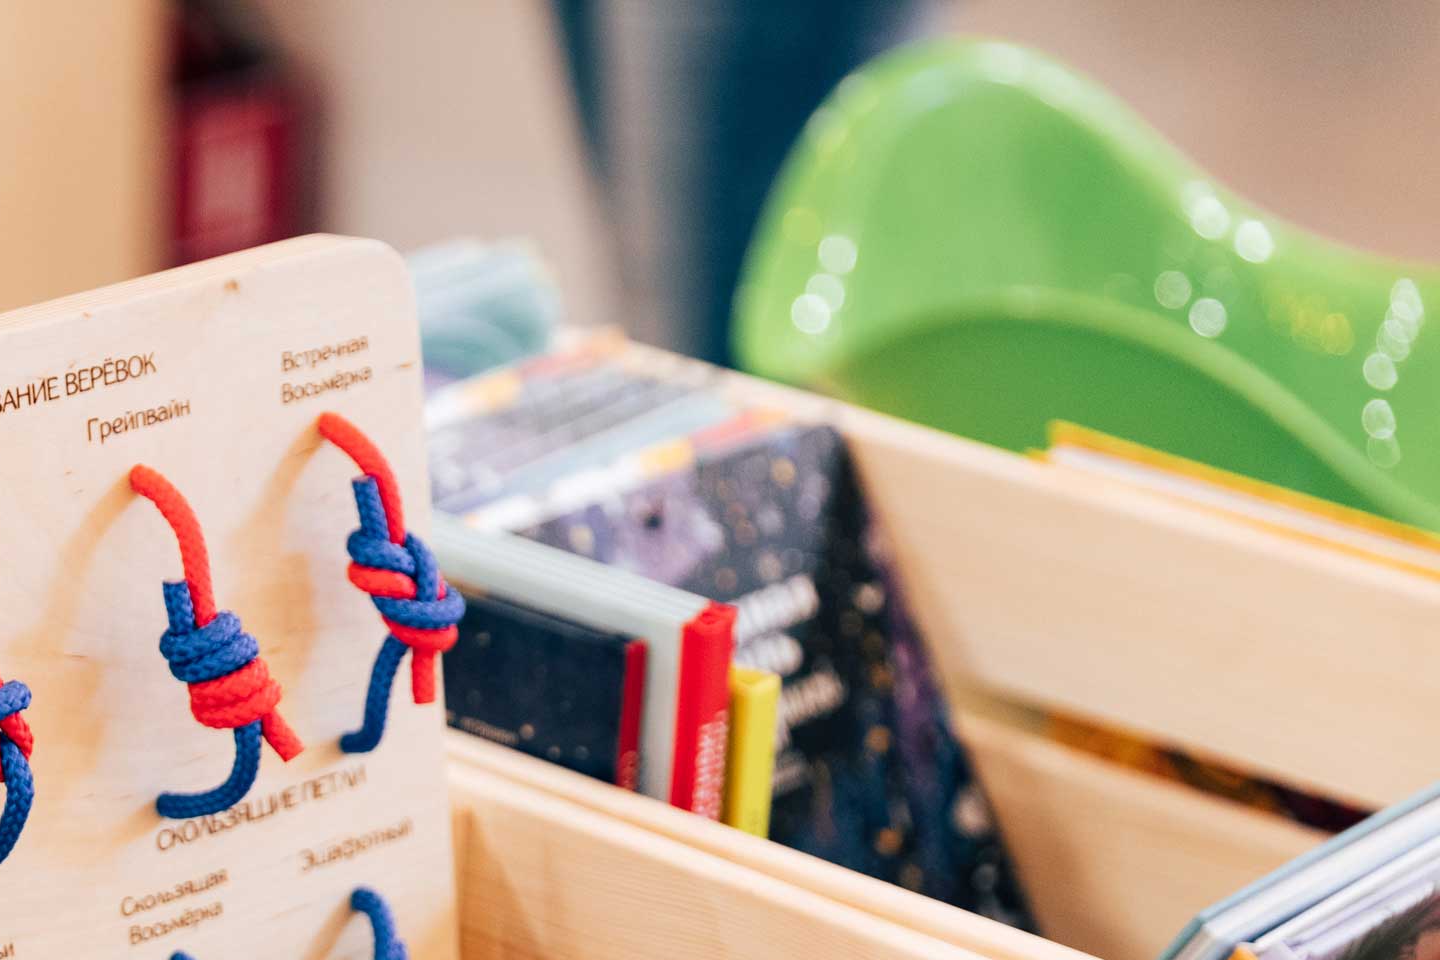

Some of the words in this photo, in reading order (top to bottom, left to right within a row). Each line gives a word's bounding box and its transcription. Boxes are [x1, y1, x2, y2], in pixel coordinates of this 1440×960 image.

[63, 351, 157, 397] ВЕРЁВОК
[281, 335, 369, 372] Встречная
[86, 398, 192, 445] Грейпвайн
[155, 790, 296, 852] СКОЛЬЗЯЩИЕ
[301, 764, 368, 802] ПЕТЛИ
[120, 868, 230, 918] Скользящая
[128, 902, 224, 946] Восьмёрка
